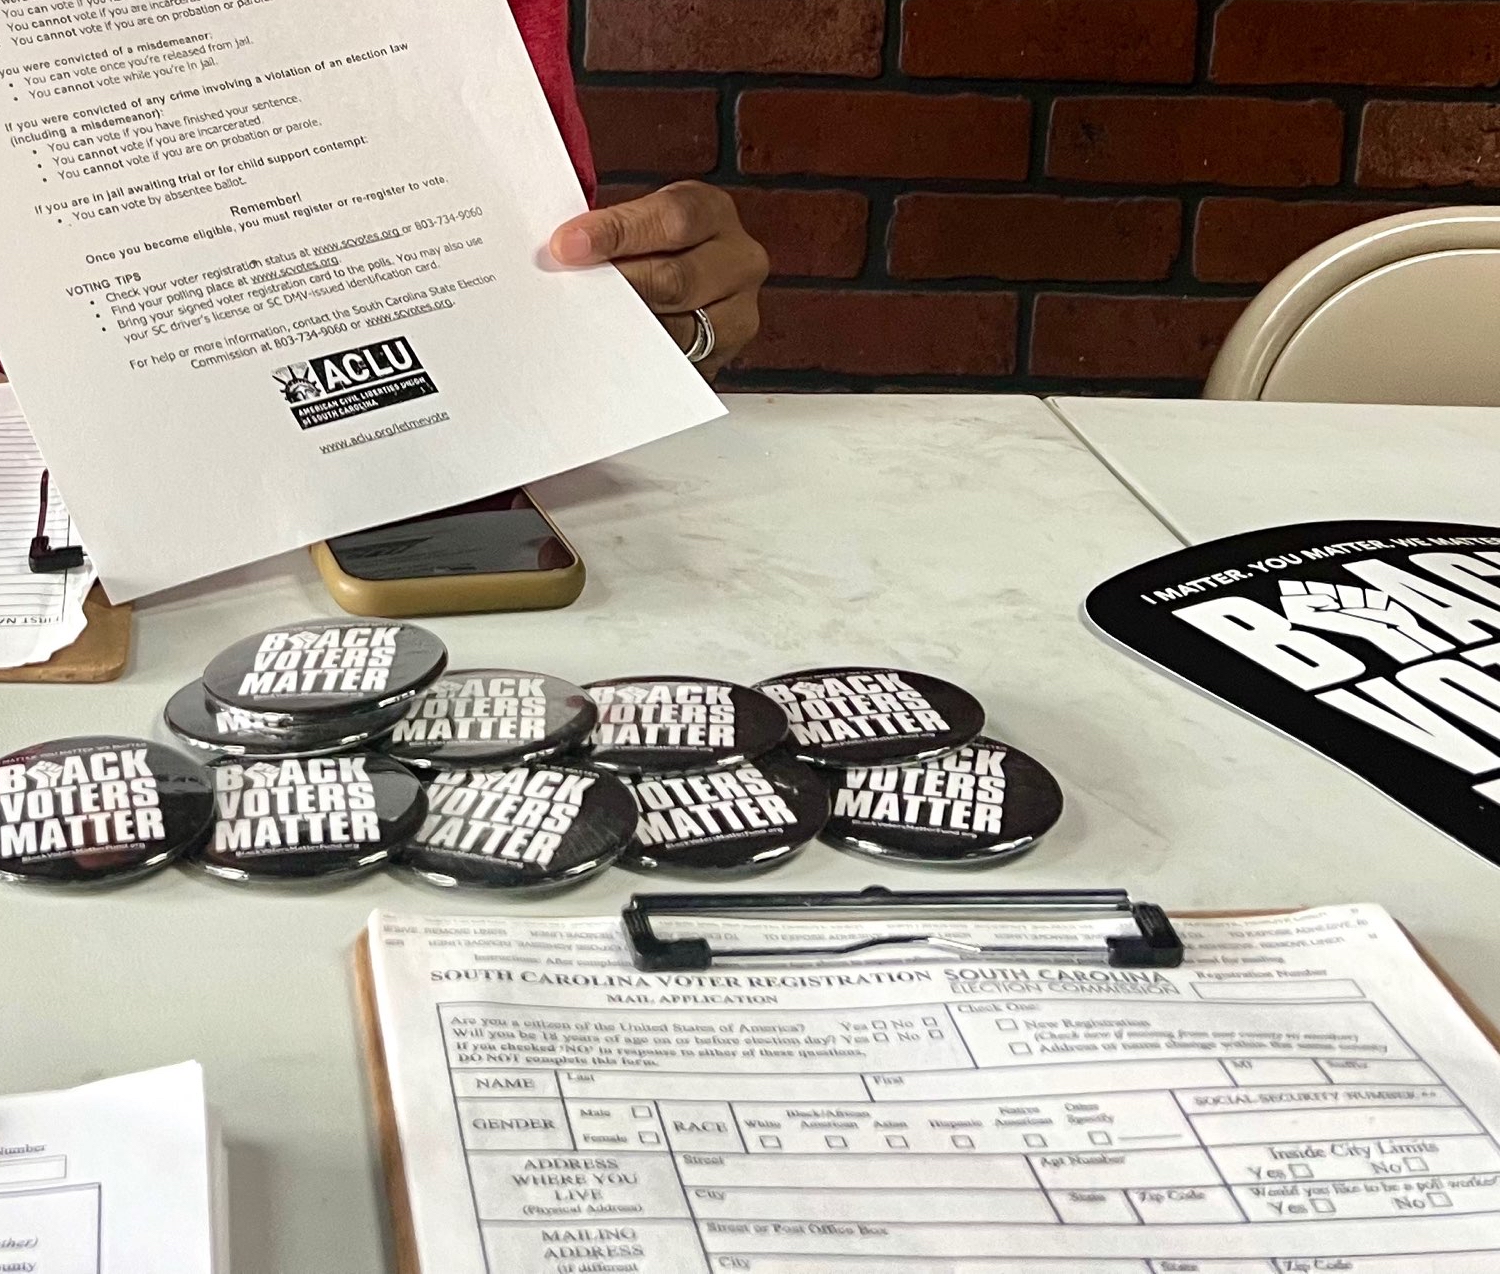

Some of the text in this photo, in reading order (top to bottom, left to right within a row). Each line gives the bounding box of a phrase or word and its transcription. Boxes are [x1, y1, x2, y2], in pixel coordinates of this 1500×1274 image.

[6, 22, 29, 32] You
[31, 14, 73, 29] cannot
[72, 11, 98, 22] vote
[98, 7, 106, 18] if
[108, 7, 129, 18] you
[130, 4, 148, 13] are
[4, 43, 408, 133] If you were convicted of any crime involving a violation of an election law
[229, 191, 302, 217] Remember!
[85, 252, 116, 264] Once
[118, 246, 141, 260] you
[143, 235, 189, 251] become
[193, 224, 237, 240] eligible,
[238, 218, 260, 232] you
[262, 210, 291, 224] must
[292, 202, 333, 218] register
[337, 198, 348, 207] or
[408, 182, 420, 191] to
[65, 272, 142, 297] VOTING TIPS
[323, 340, 413, 391] ACLU
[298, 399, 339, 417] AMERICAN
[339, 394, 359, 408] CIVIL
[312, 410, 339, 425] SOUTH
[339, 399, 379, 418] CAROLINA
[1140, 593, 1158, 605] I
[1153, 567, 1254, 602] MATTER.
[1248, 553, 1303, 574] YOU
[1300, 538, 1396, 562] MATTER.
[1390, 538, 1432, 547] WE
[254, 646, 396, 672] VOTERS
[238, 668, 390, 695] MATTER
[781, 690, 932, 724] VOTERS
[392, 717, 546, 743] MATTER
[788, 710, 950, 746] MATTER
[629, 767, 775, 812] OTERS
[846, 768, 1006, 804] VOTERS
[0, 777, 160, 823] VOTERS
[217, 782, 376, 819] VOTERS
[426, 783, 580, 835] VOTERS
[834, 788, 1003, 835] MATTER
[0, 807, 165, 859] MATTER
[215, 810, 381, 852] MATTER
[635, 794, 798, 847] MATTER
[430, 968, 933, 988] SOUTH CAROLINA VOTER REGISTRATION
[943, 968, 1170, 984] SOUTH CAROLINA
[951, 981, 1180, 995] ELECTION COMMISSION
[659, 994, 778, 1004] APPLICATION
[476, 1078, 535, 1089] NAME
[472, 1118, 555, 1130] GENDER
[672, 1121, 728, 1133] RACE
[1331, 1142, 1371, 1159] City
[1376, 1139, 1439, 1155] Limits
[524, 1158, 619, 1170] ADDRESS
[511, 1173, 638, 1186] WHERE YOU
[554, 1189, 603, 1201] LIVE
[544, 1244, 644, 1259] ADDRESS
